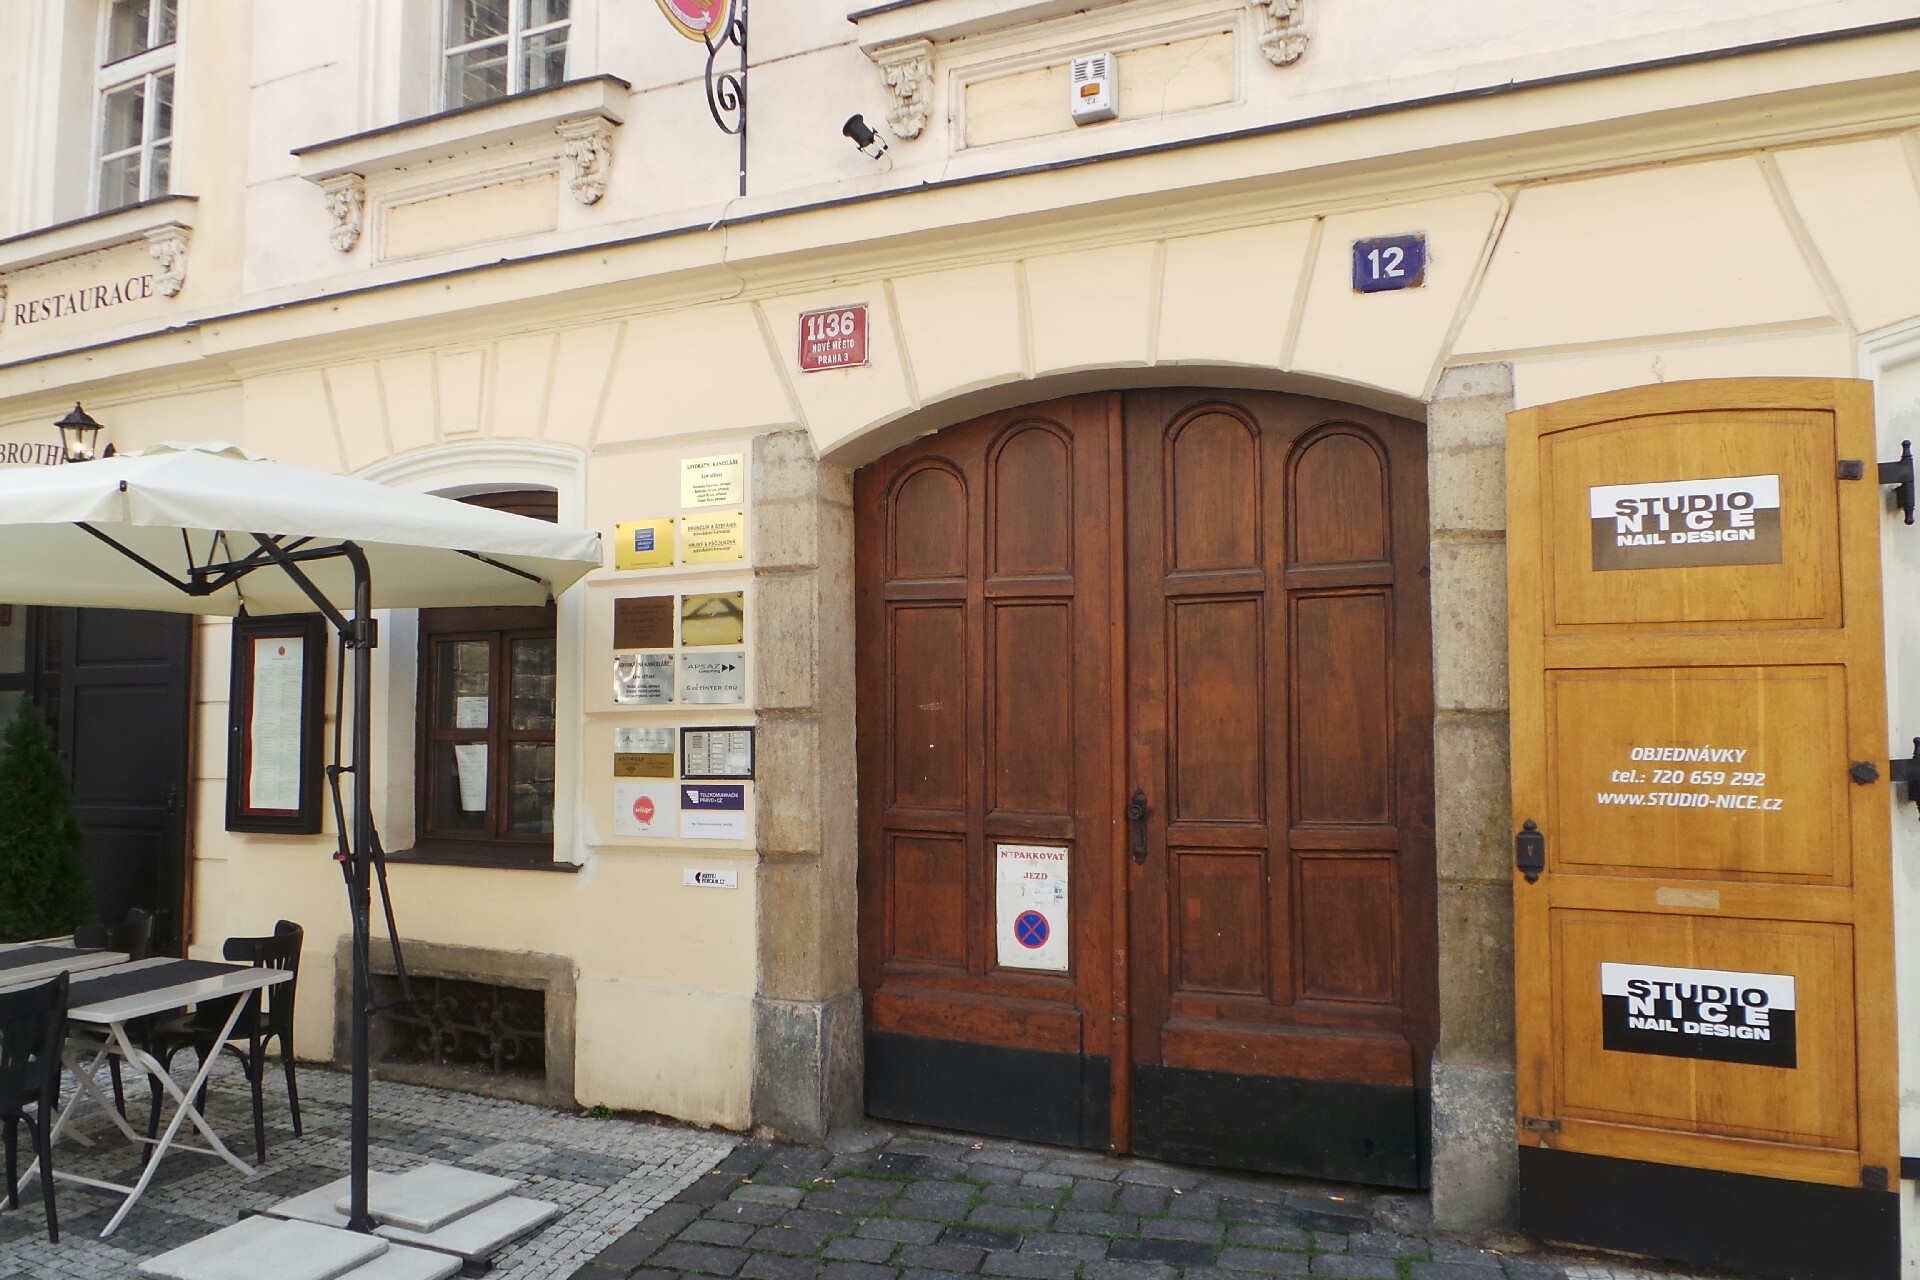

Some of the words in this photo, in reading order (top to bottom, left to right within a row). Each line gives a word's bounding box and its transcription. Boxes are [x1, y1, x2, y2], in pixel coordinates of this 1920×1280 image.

[1367, 246, 1405, 279] 12
[14, 274, 154, 326] RESTAURACE
[807, 311, 855, 341] 1136
[812, 340, 831, 353] NOVÉ
[832, 338, 855, 350] MĚSTO
[818, 353, 842, 365] PRAHA
[843, 352, 849, 362] 3
[1615, 491, 1754, 517] STUDIO
[1616, 509, 1755, 533] NICE
[1617, 533, 1666, 547] NAIL
[1671, 528, 1756, 544] DESIGN
[1630, 745, 1747, 763] OBJEDNÁVKY
[1611, 769, 1646, 783] tel.:
[1652, 769, 1685, 784] 720
[1689, 770, 1726, 785] 659
[1730, 772, 1766, 787] 292
[1597, 792, 1784, 811] www.STUDIO-NICE.cz
[1627, 979, 1770, 1008] STUDIO
[1628, 995, 1771, 1026] NICE
[1628, 1017, 1679, 1033] NAIL
[1683, 1021, 1771, 1041] DESIGN
